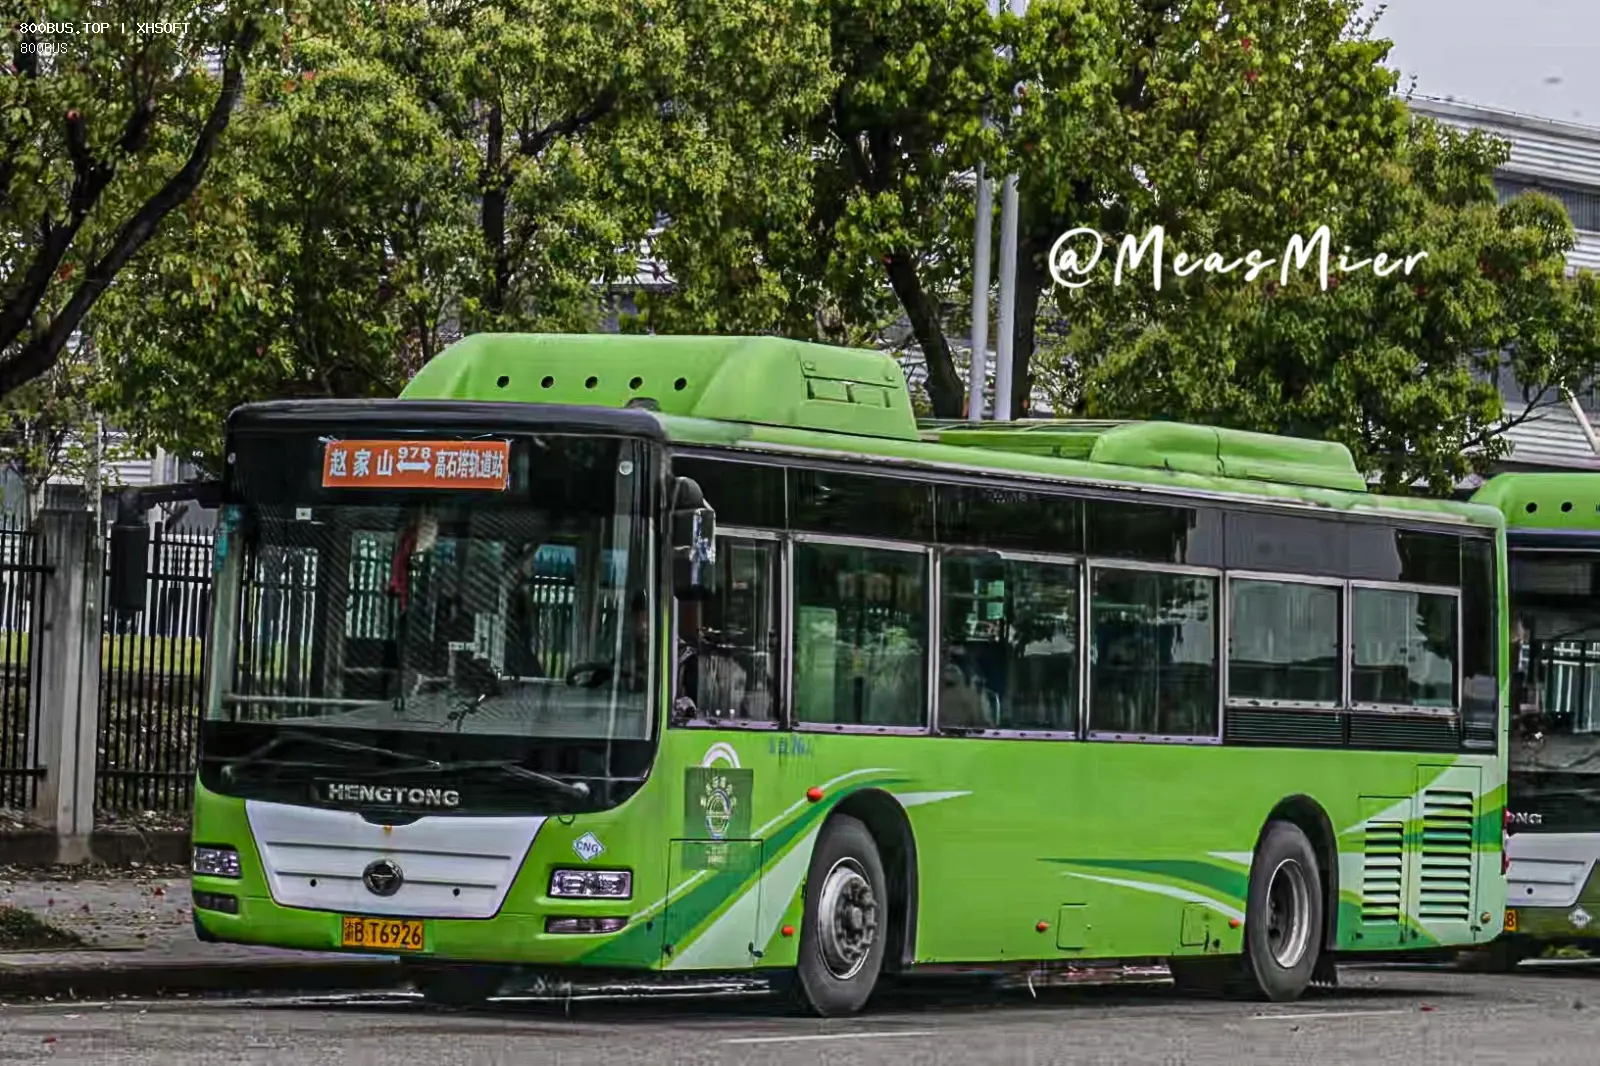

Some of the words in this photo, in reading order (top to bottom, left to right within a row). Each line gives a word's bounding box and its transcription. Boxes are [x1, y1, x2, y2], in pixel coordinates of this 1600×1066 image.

[329, 449, 394, 477] 赵家山
[398, 446, 432, 459] 978
[434, 449, 505, 479] 高石塔轨道站
[328, 783, 460, 806] HENGTONG
[576, 841, 599, 853] CNG
